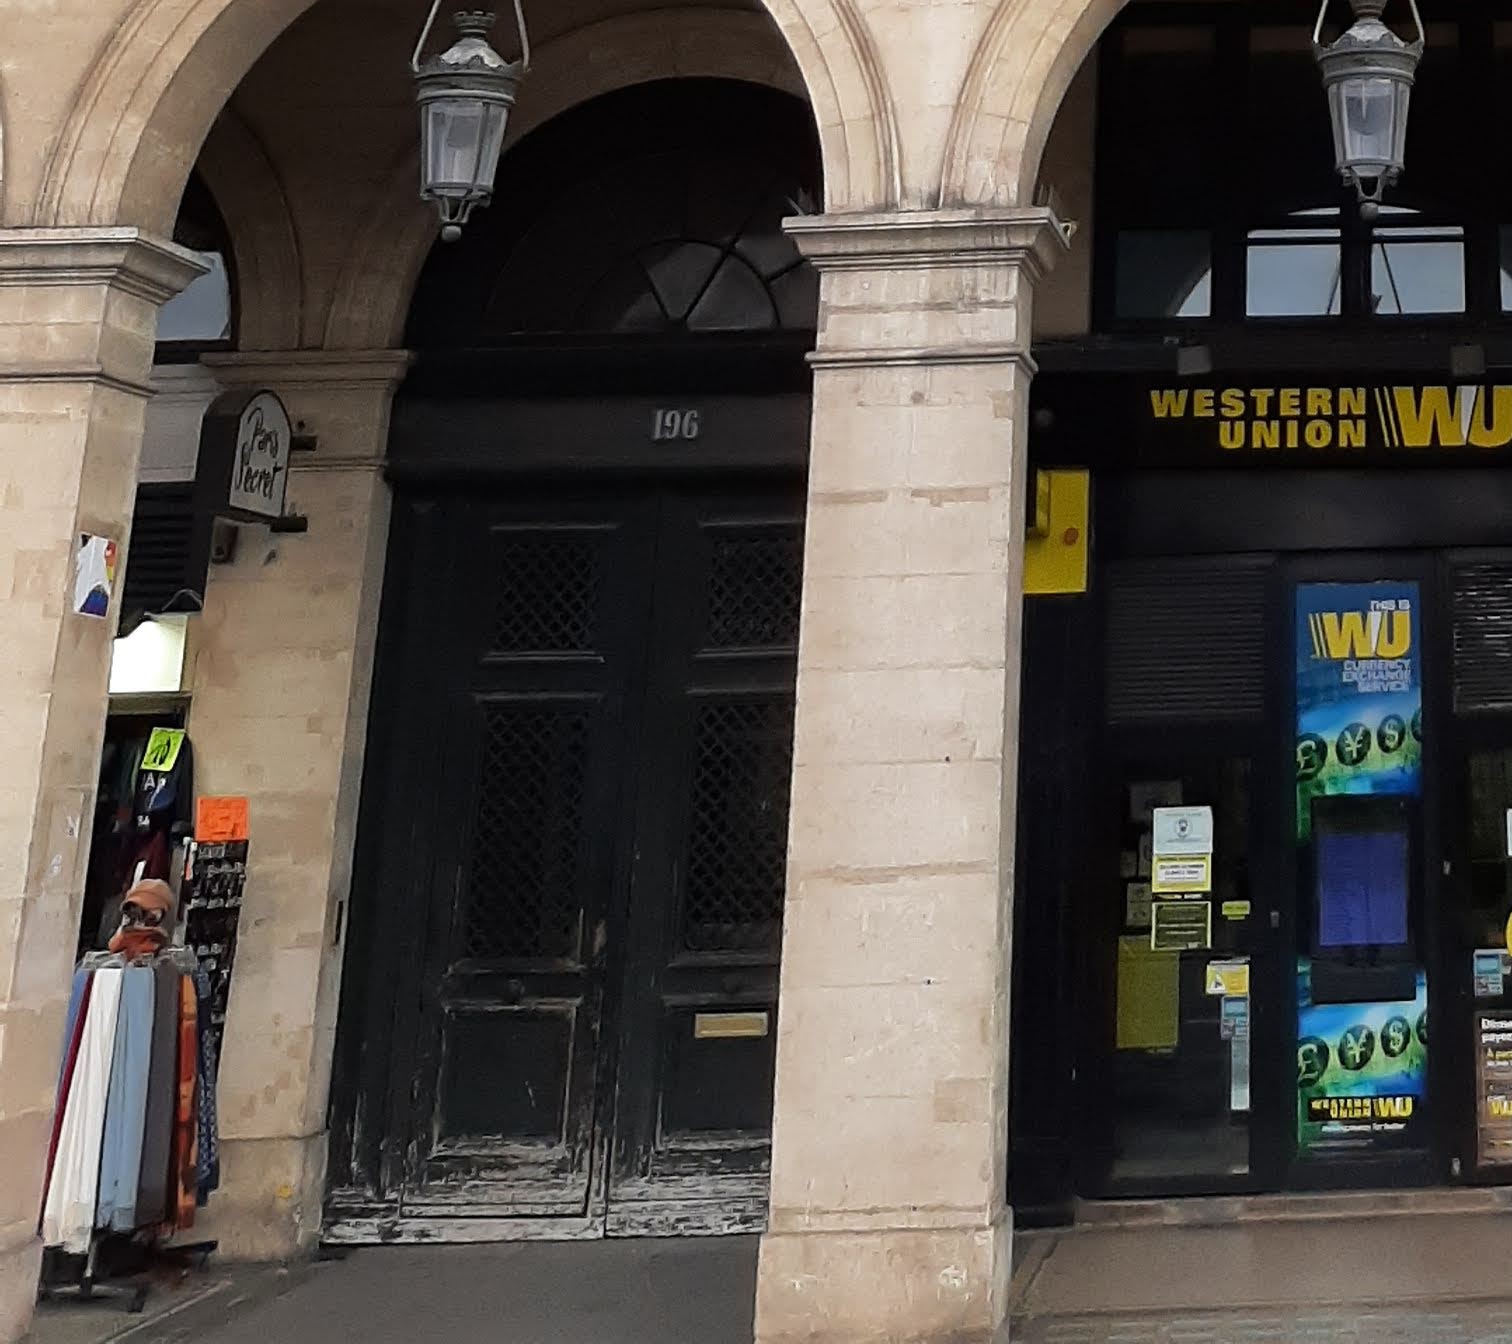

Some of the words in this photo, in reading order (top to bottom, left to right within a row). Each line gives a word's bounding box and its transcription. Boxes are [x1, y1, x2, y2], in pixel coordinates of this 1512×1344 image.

[1151, 388, 1366, 417] WESTERN
[652, 409, 699, 439] 196
[1219, 420, 1366, 448] UNION
[1322, 611, 1411, 659] WU
[1342, 670, 1411, 682] EXCHANGE
[1344, 659, 1411, 671] CURRENCY
[1358, 681, 1410, 693] SERVICE
